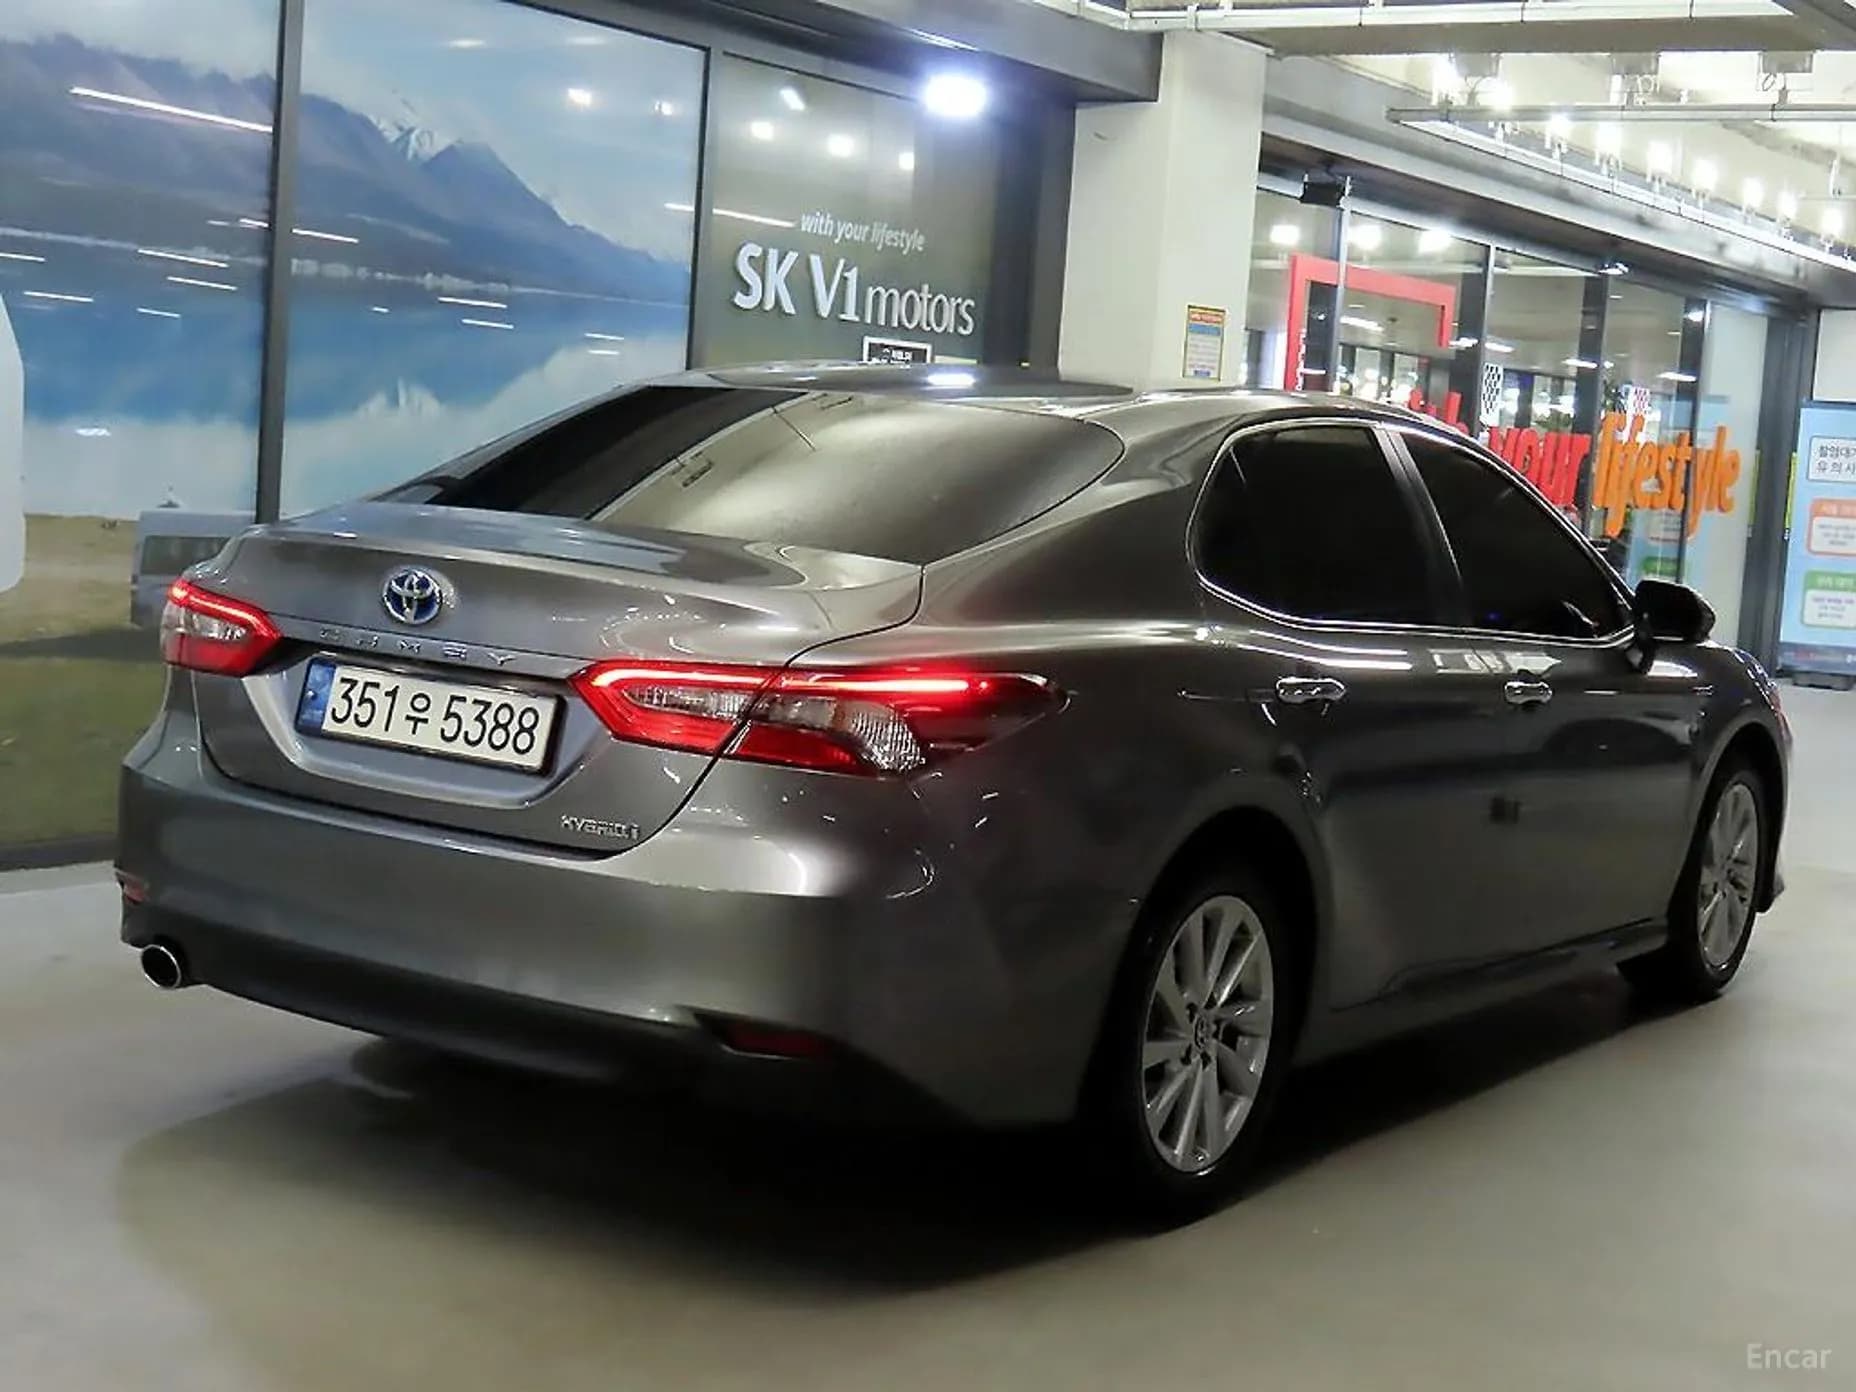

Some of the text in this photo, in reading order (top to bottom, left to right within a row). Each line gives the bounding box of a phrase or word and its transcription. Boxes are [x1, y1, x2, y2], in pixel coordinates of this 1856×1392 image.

[801, 211, 926, 255] with your lifestyle
[734, 241, 976, 336] SK V1 motors
[1591, 411, 1741, 540] lifestyle
[331, 677, 541, 756] 351우 5388
